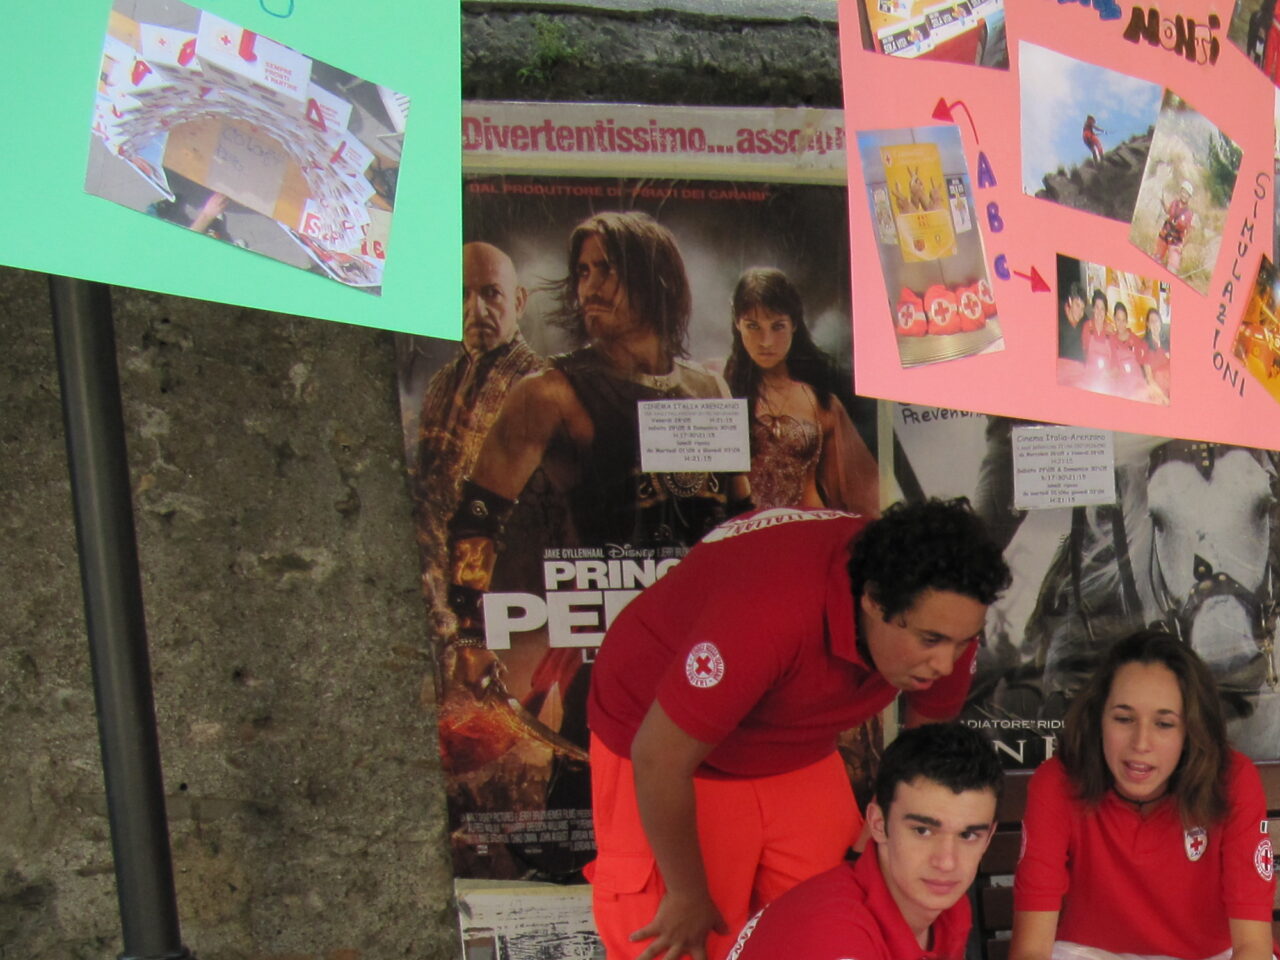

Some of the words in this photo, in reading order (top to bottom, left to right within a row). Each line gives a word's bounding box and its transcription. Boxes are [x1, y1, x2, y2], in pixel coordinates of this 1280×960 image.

[978, 151, 997, 188] A
[986, 202, 1004, 232] B
[544, 549, 561, 559] JAKE
[562, 549, 604, 559] GYLLENHAAL
